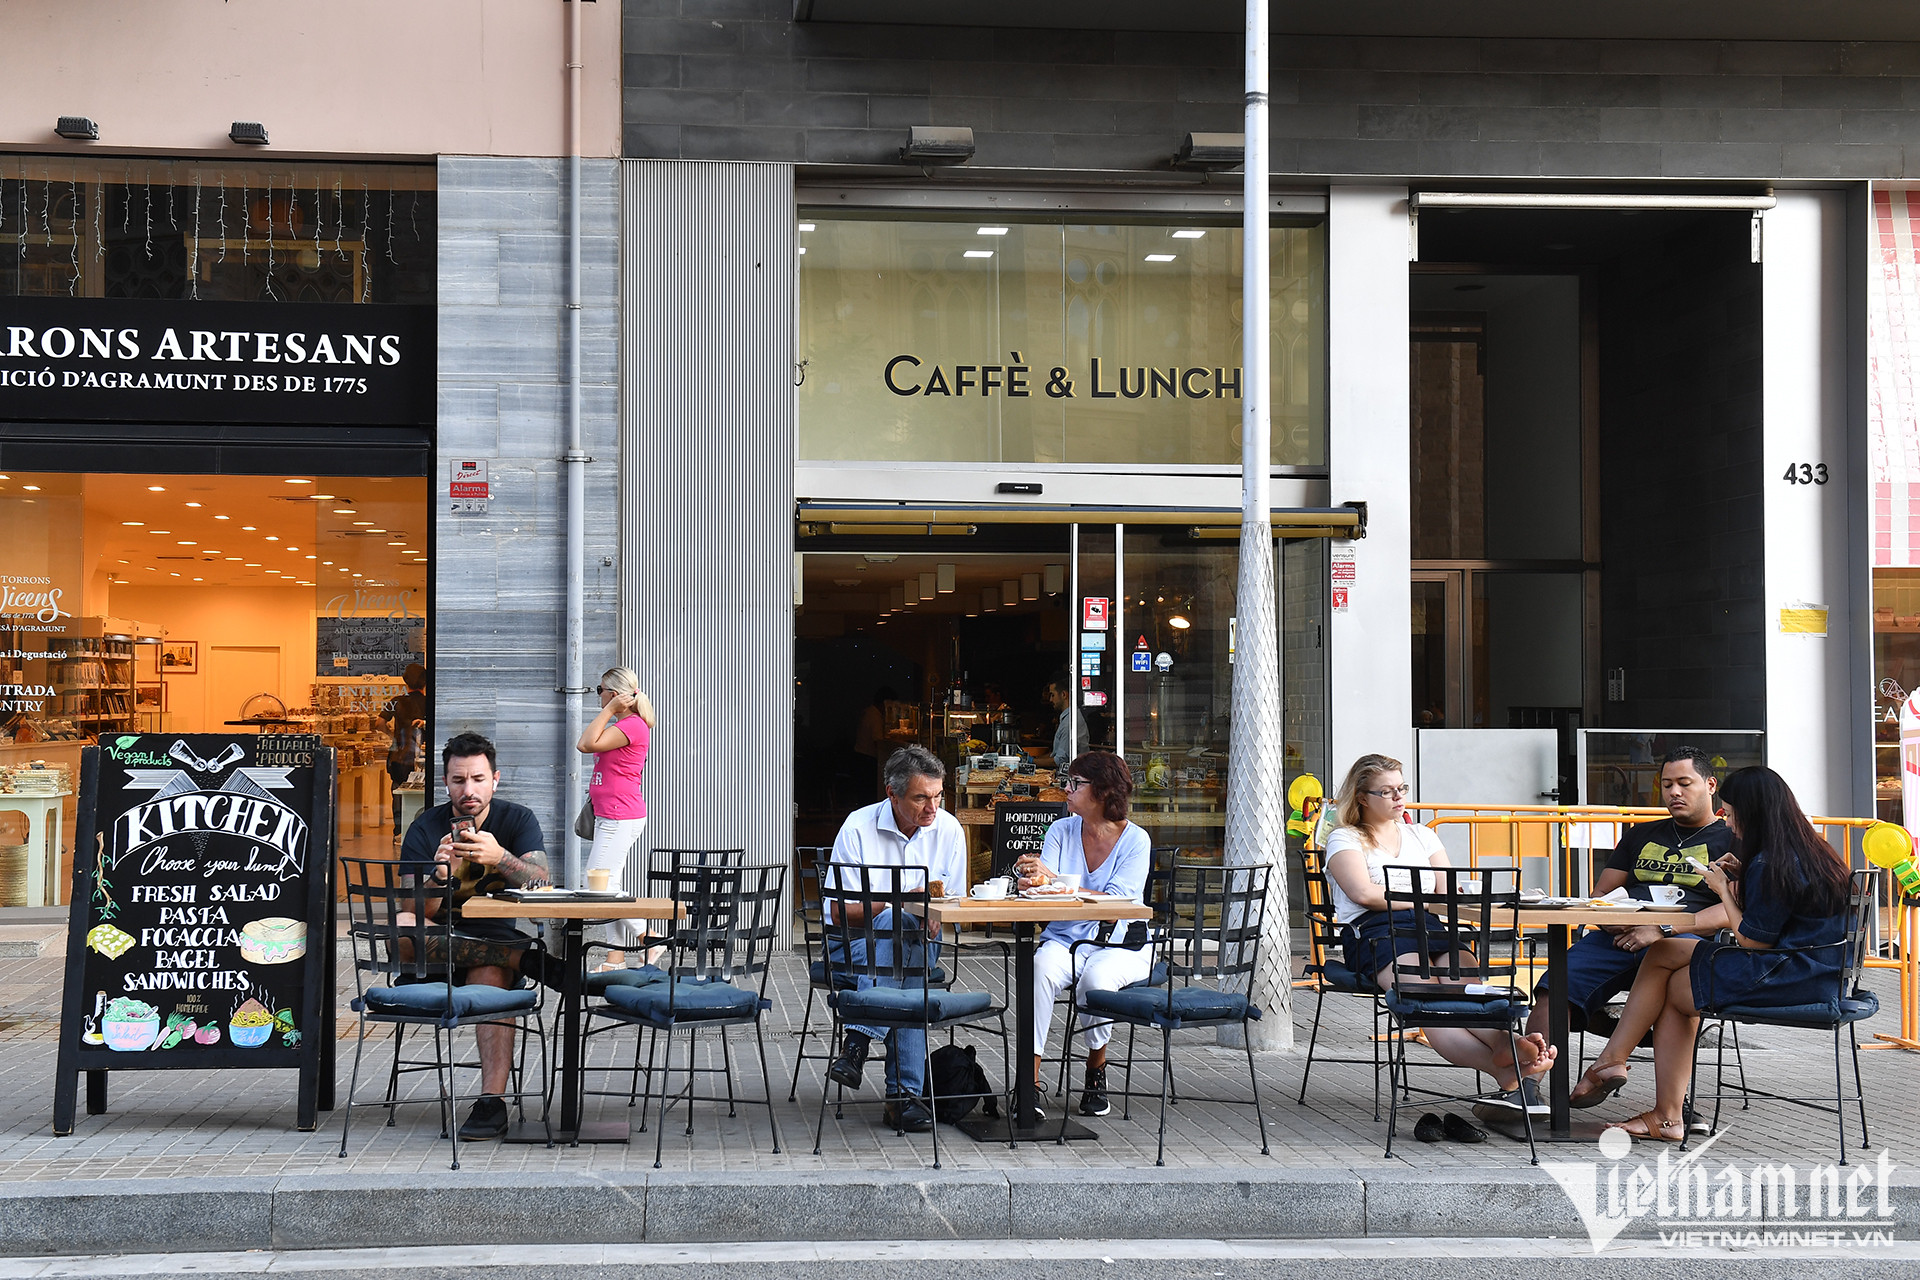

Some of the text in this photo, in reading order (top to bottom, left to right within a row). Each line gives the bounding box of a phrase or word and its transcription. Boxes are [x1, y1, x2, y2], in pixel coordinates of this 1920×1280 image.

[0, 326, 402, 366] RONS ARTESANS
[62, 370, 226, 391] D'AGRAMUNT
[233, 374, 278, 392] DES
[284, 376, 317, 393] DE
[323, 377, 368, 395] 1775
[883, 351, 1243, 399] CAFFÈ & LUNCH
[1783, 462, 1829, 485] 433
[1, 575, 51, 584] TORRONS
[14, 650, 67, 660] Degustació
[338, 685, 409, 697] ENTRADA
[0, 700, 44, 712] NTRY
[350, 700, 398, 712] ENTRY
[261, 738, 312, 751] RELIABLE
[104, 746, 148, 765] Vegan
[131, 750, 172, 767] products
[260, 752, 312, 765] PRODUCTS
[125, 794, 306, 861] KITCHEN
[1010, 824, 1044, 835] CAKES
[140, 846, 300, 882] Choose your lunch
[131, 882, 281, 903] FRESH SALAD
[159, 905, 230, 925] PASTA
[140, 927, 242, 948] FOCACCIA
[155, 949, 220, 969] BAGEL
[123, 969, 250, 992] SANDWICHES
